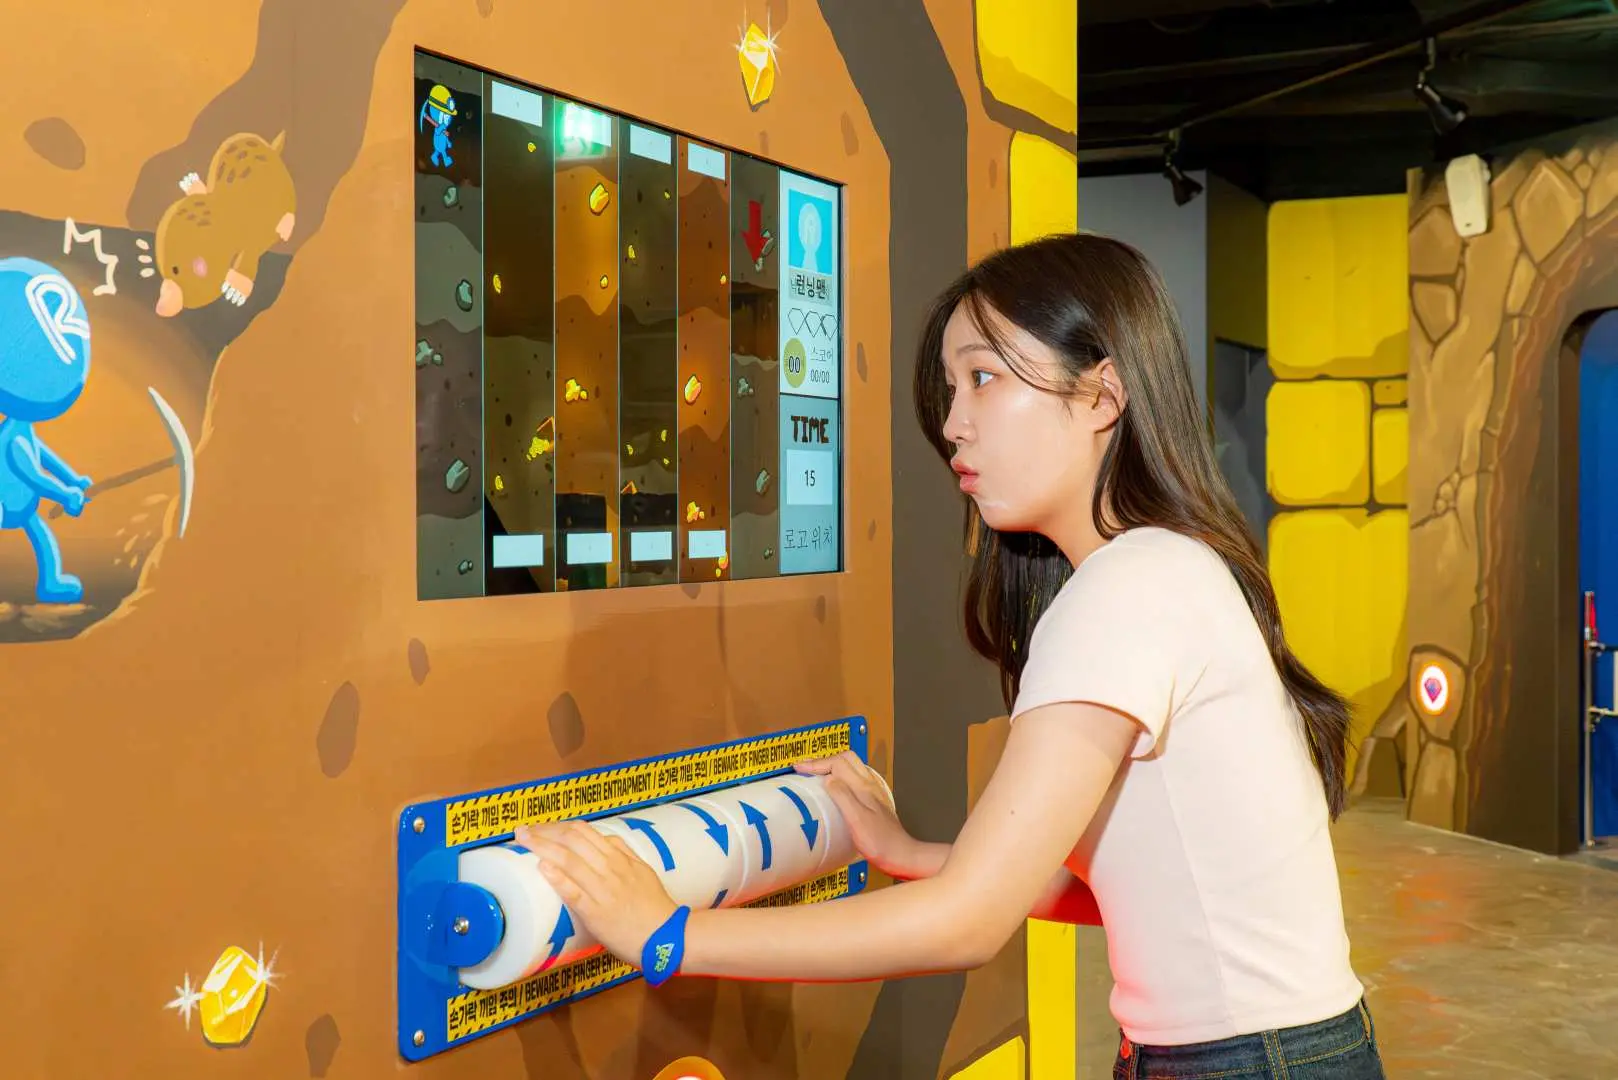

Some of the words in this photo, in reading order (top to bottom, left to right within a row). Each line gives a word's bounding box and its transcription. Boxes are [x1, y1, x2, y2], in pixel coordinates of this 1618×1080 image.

[788, 355, 801, 374] 00
[790, 415, 829, 443] TIME
[804, 469, 816, 487] 15
[451, 808, 479, 836] 손가락
[481, 804, 499, 827] 끼임
[501, 799, 519, 822] 주의
[527, 792, 561, 818] BEWARE
[562, 787, 574, 810] OF
[575, 783, 602, 807] FINGER
[603, 772, 652, 802] ENTRAPMENT
[658, 766, 679, 788] 손가락
[695, 760, 708, 781] 주의
[713, 754, 739, 775] BEWARE
[740, 752, 748, 769] OF
[749, 748, 770, 768] FINGER
[770, 740, 807, 764] ENTRAPMENT
[449, 1003, 477, 1030] 손가락
[479, 995, 497, 1017] 끼임
[499, 990, 517, 1012] 주의
[525, 972, 559, 1001] BEWARE
[561, 966, 572, 989] OF
[573, 959, 600, 985] FINGER
